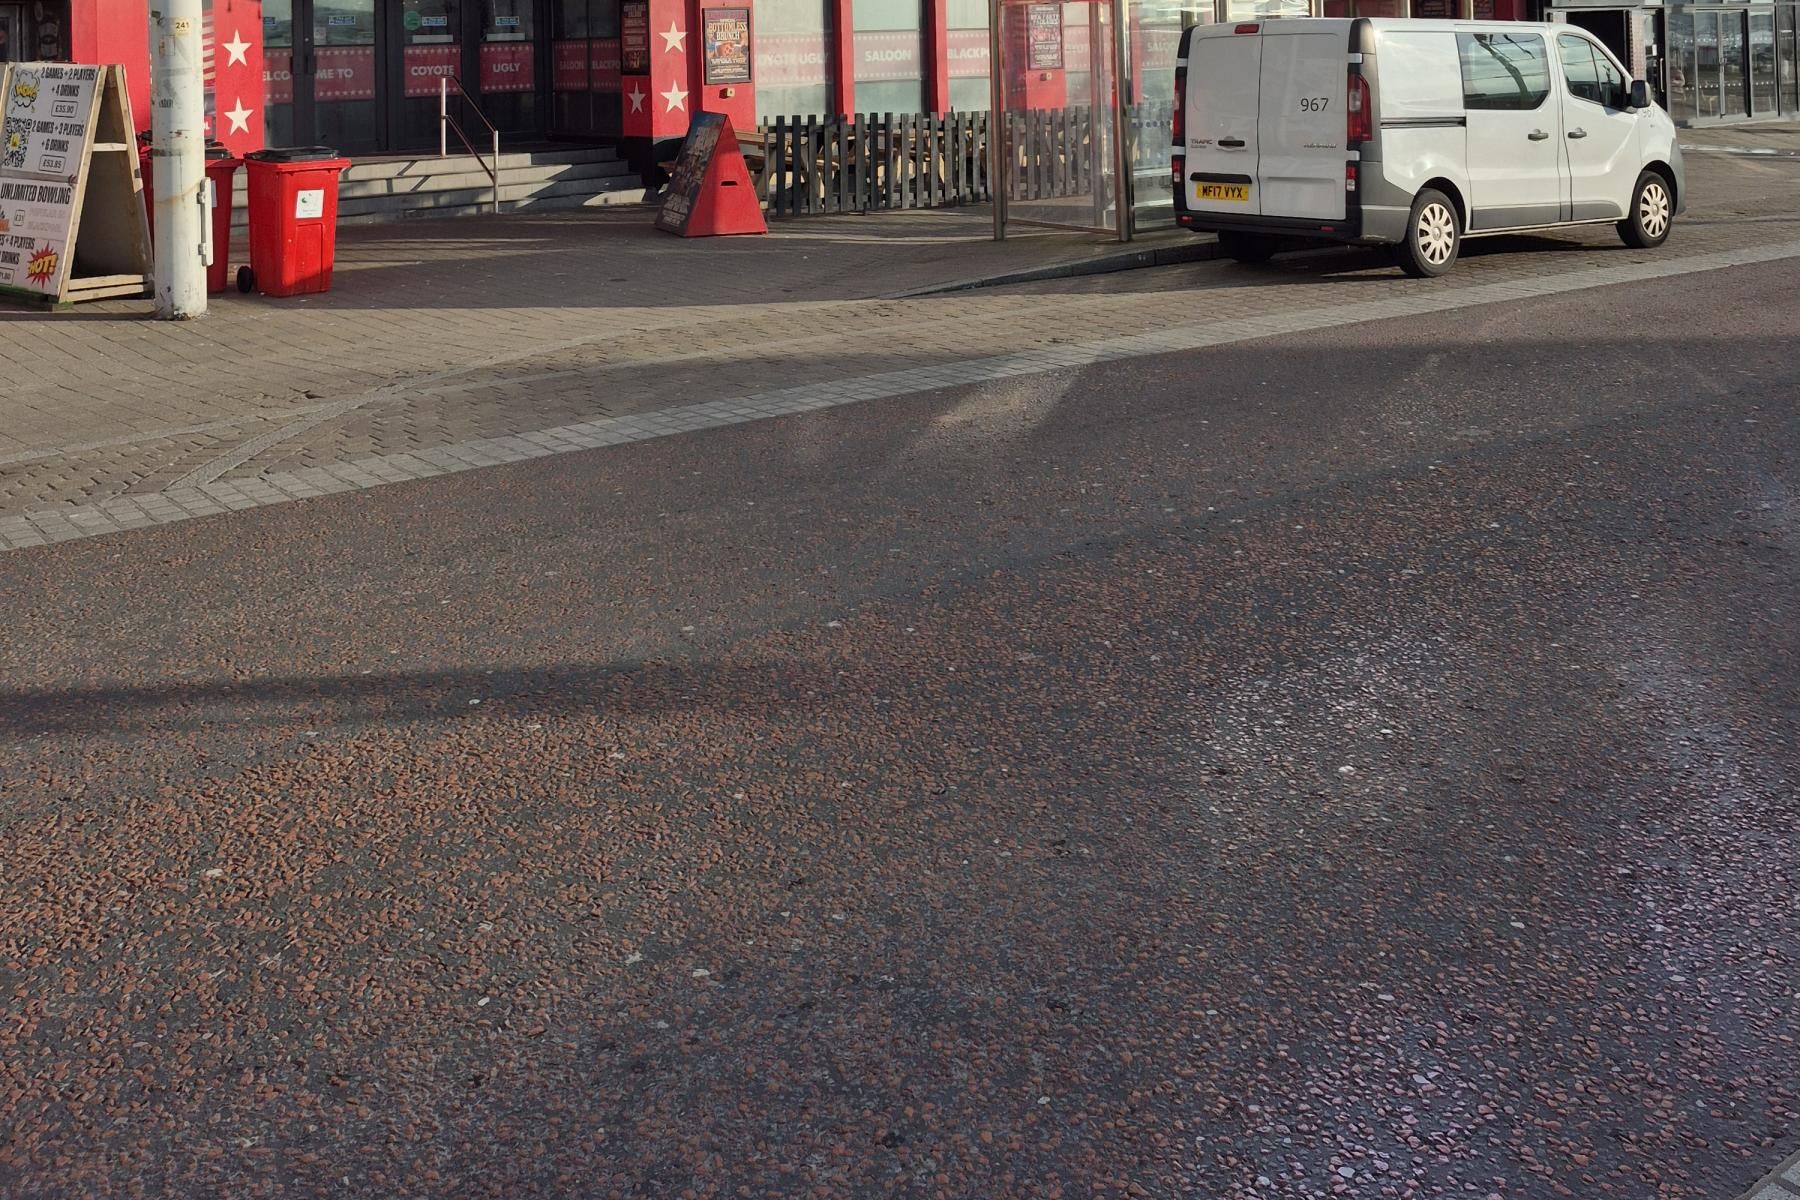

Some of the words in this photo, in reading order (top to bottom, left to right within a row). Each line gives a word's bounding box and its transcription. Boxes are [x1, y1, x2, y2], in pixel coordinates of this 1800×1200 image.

[864, 49, 912, 62] SALOON
[947, 47, 990, 60] BLACKP
[45, 67, 64, 80] GAMES
[73, 68, 96, 81] PLAYERS
[336, 68, 353, 79] TO
[411, 64, 455, 77] COYOTE
[492, 63, 521, 73] UGLY
[60, 84, 80, 97] DRINKS
[1300, 97, 1329, 112] 967
[36, 121, 55, 134] GAMES
[63, 123, 85, 137] PLAYERS
[49, 139, 70, 152] DRINKS
[1, 183, 38, 202] UNLIMITED
[37, 186, 71, 204] BOWLING
[1202, 185, 1222, 197] MF17
[1224, 186, 1243, 198] VYX
